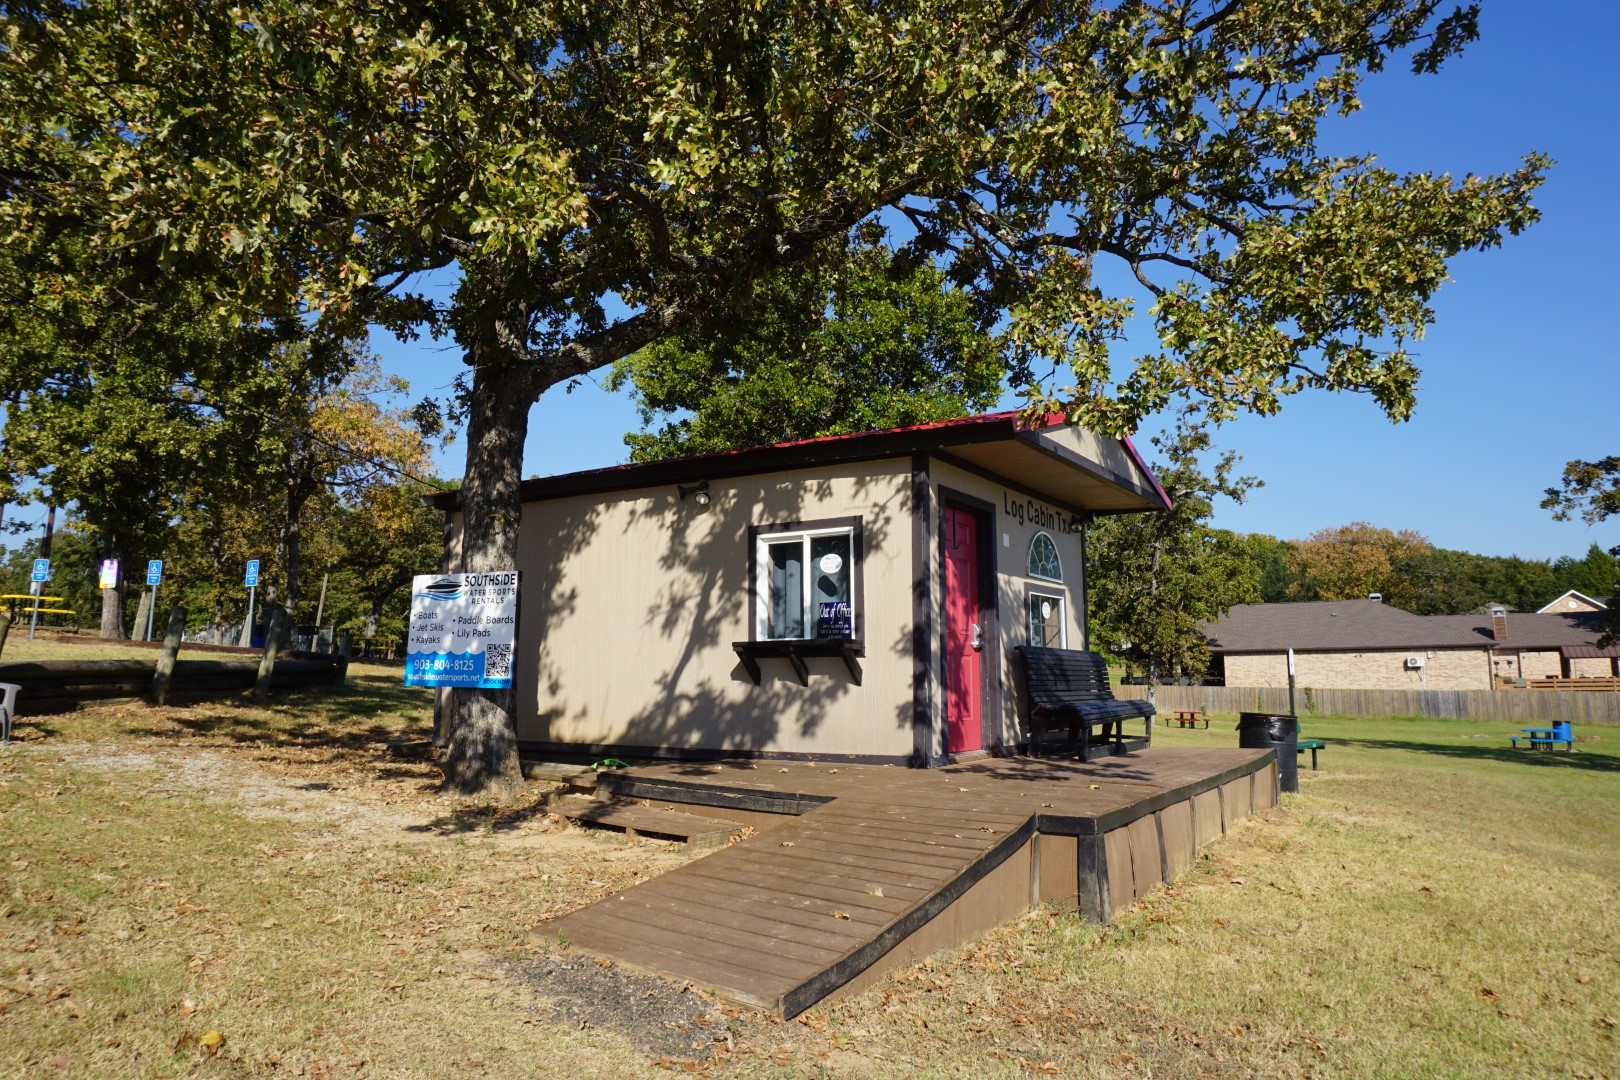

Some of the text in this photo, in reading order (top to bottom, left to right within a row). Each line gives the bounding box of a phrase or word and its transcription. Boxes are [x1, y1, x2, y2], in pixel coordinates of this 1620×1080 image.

[1004, 491, 1025, 526] Log
[1027, 501, 1054, 530] Cabin
[464, 574, 516, 587] SOUTHSIDE
[471, 597, 505, 605] RENTALS
[418, 611, 438, 620] Boats
[457, 615, 514, 625] Paddle Boards
[416, 623, 444, 632] Jet Skis
[457, 629, 491, 639] Lily Pads
[416, 636, 441, 645] Kayaks
[414, 660, 474, 671] 903-804-8125
[407, 672, 481, 683] southsidewatersports.net
